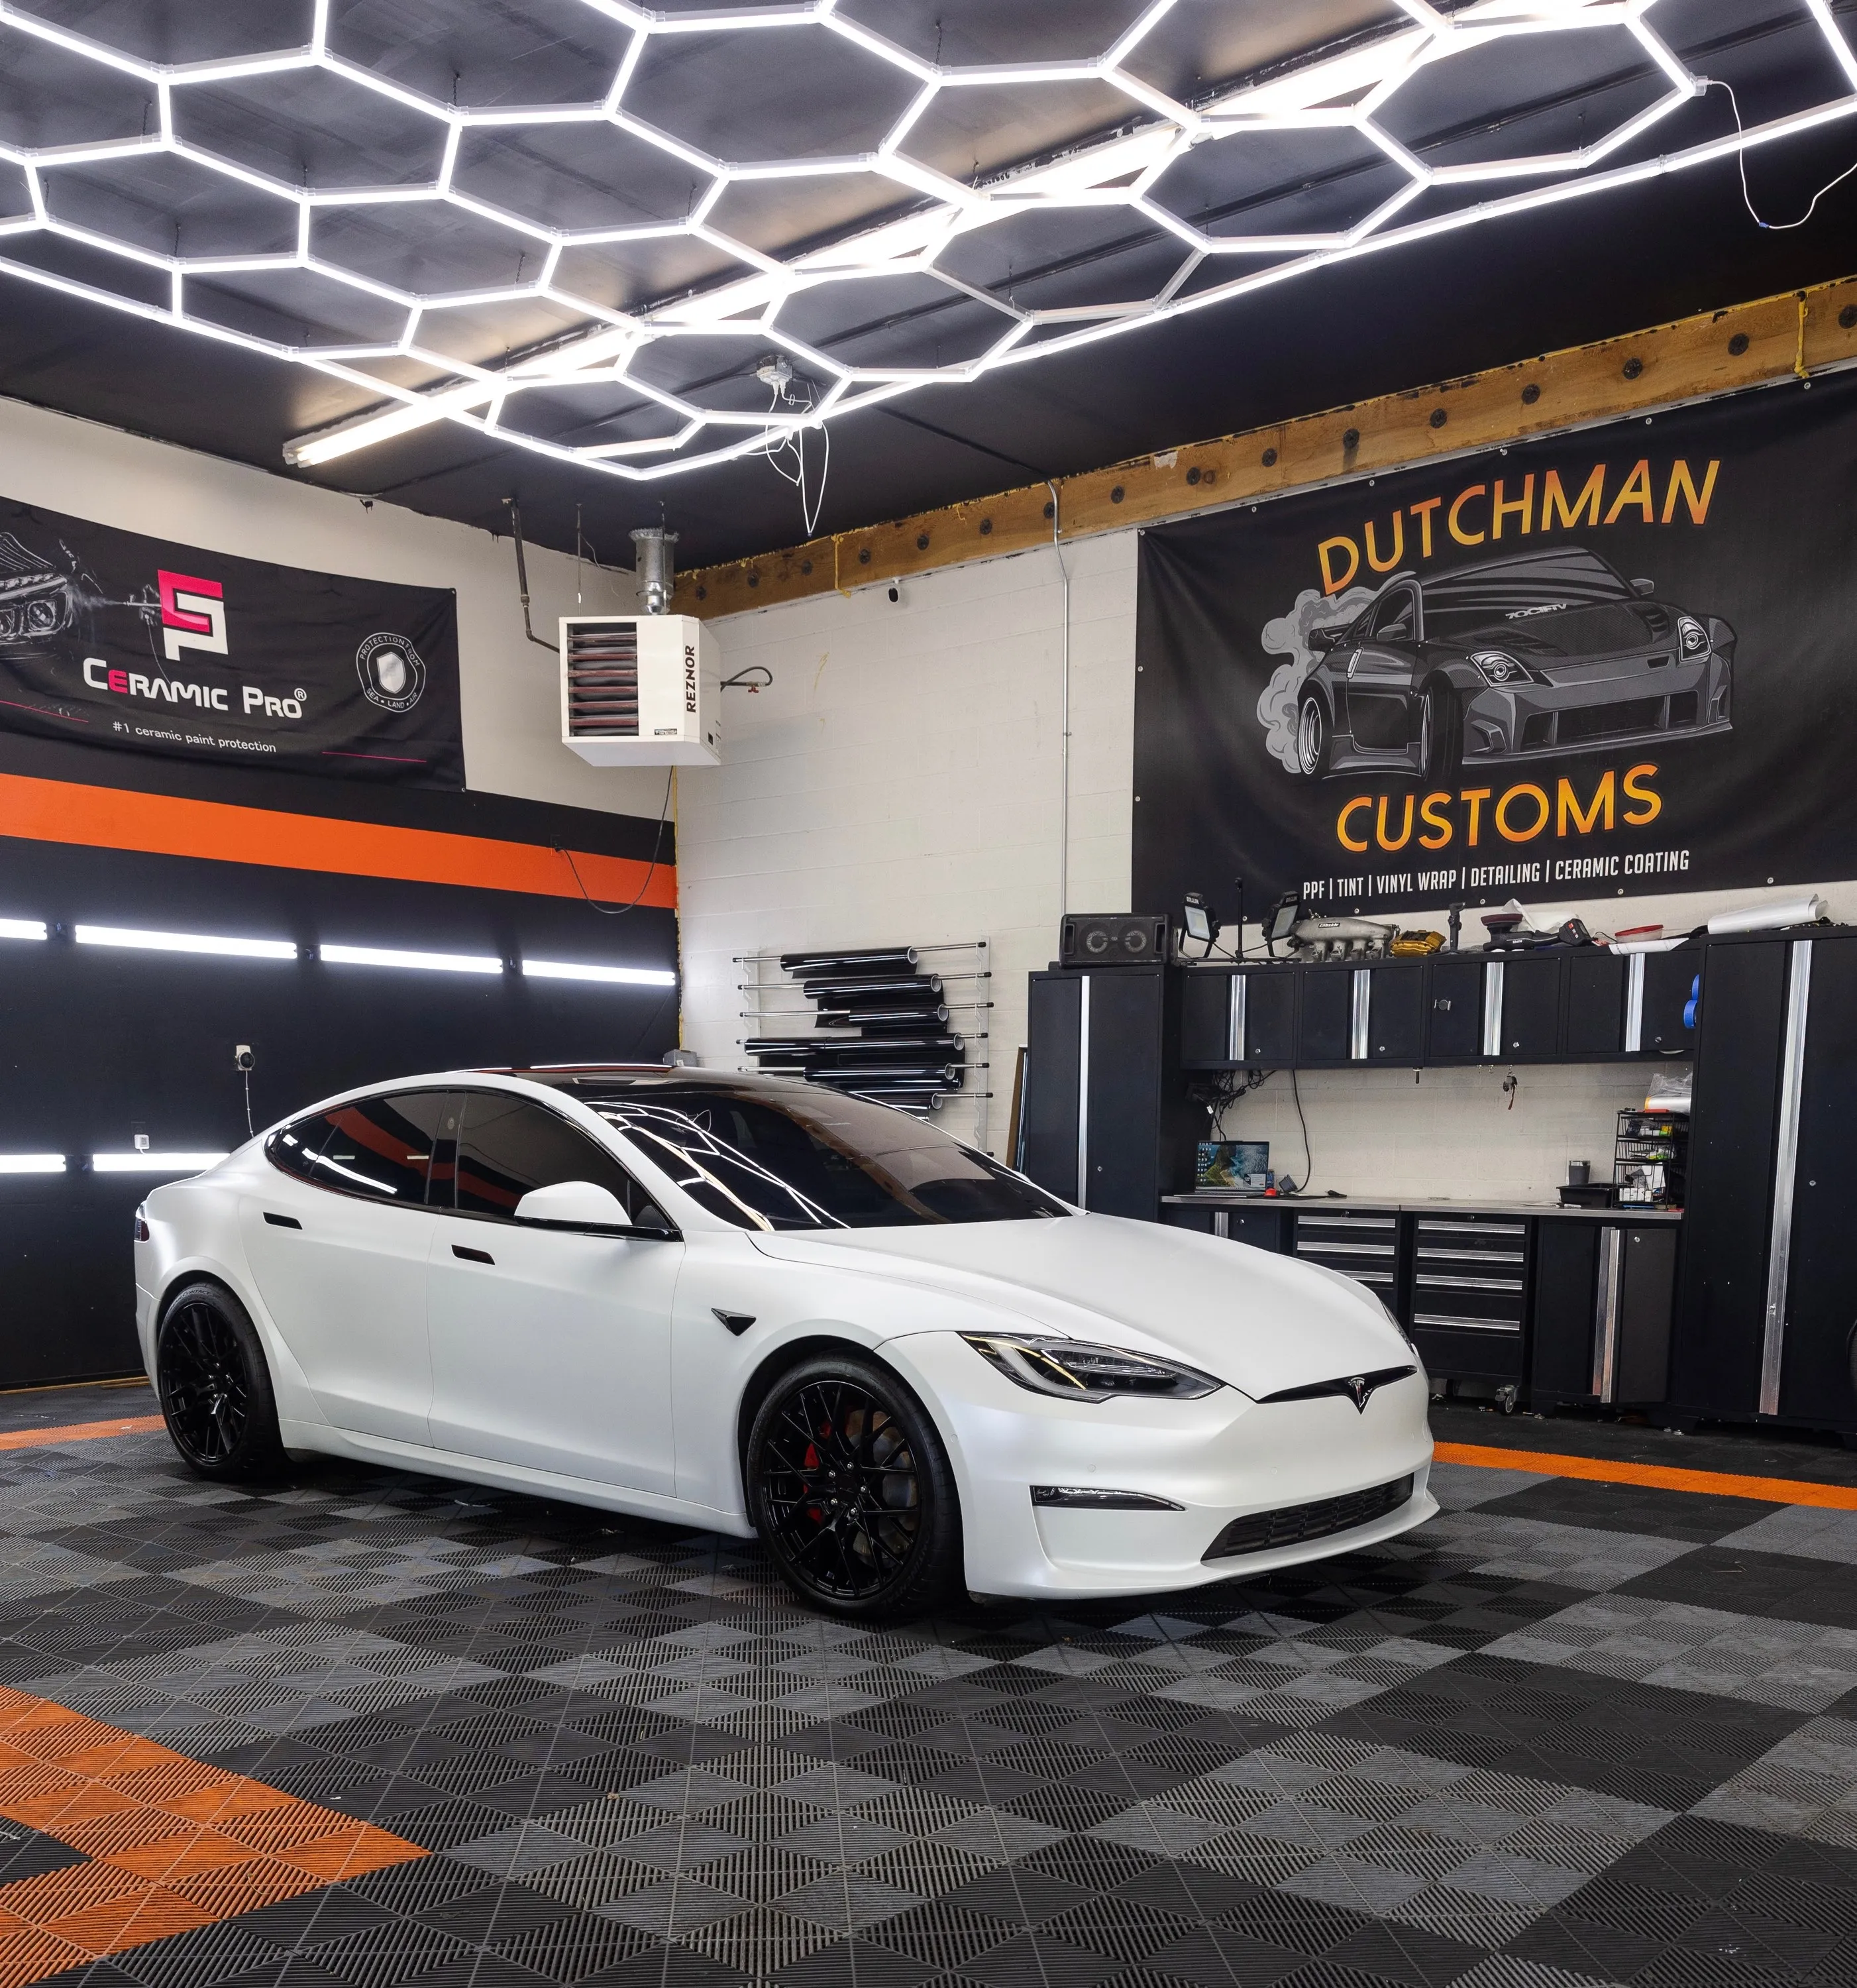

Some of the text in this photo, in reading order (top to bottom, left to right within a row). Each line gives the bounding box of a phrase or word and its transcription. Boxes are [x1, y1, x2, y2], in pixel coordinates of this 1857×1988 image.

[1316, 459, 1721, 596] DUTCHMAN
[359, 635, 420, 666] PROTECTION FROM
[83, 657, 229, 711] CERAMIC
[366, 688, 418, 708] SEA LAND AIR
[684, 645, 696, 713] REZNOR
[113, 721, 277, 753] #1 ceramic paint protection
[1336, 763, 1662, 853] CUSTOMS
[1303, 850, 1689, 900] PPF TINT VINYL WRAP DETAILING CERAMIC COATING
